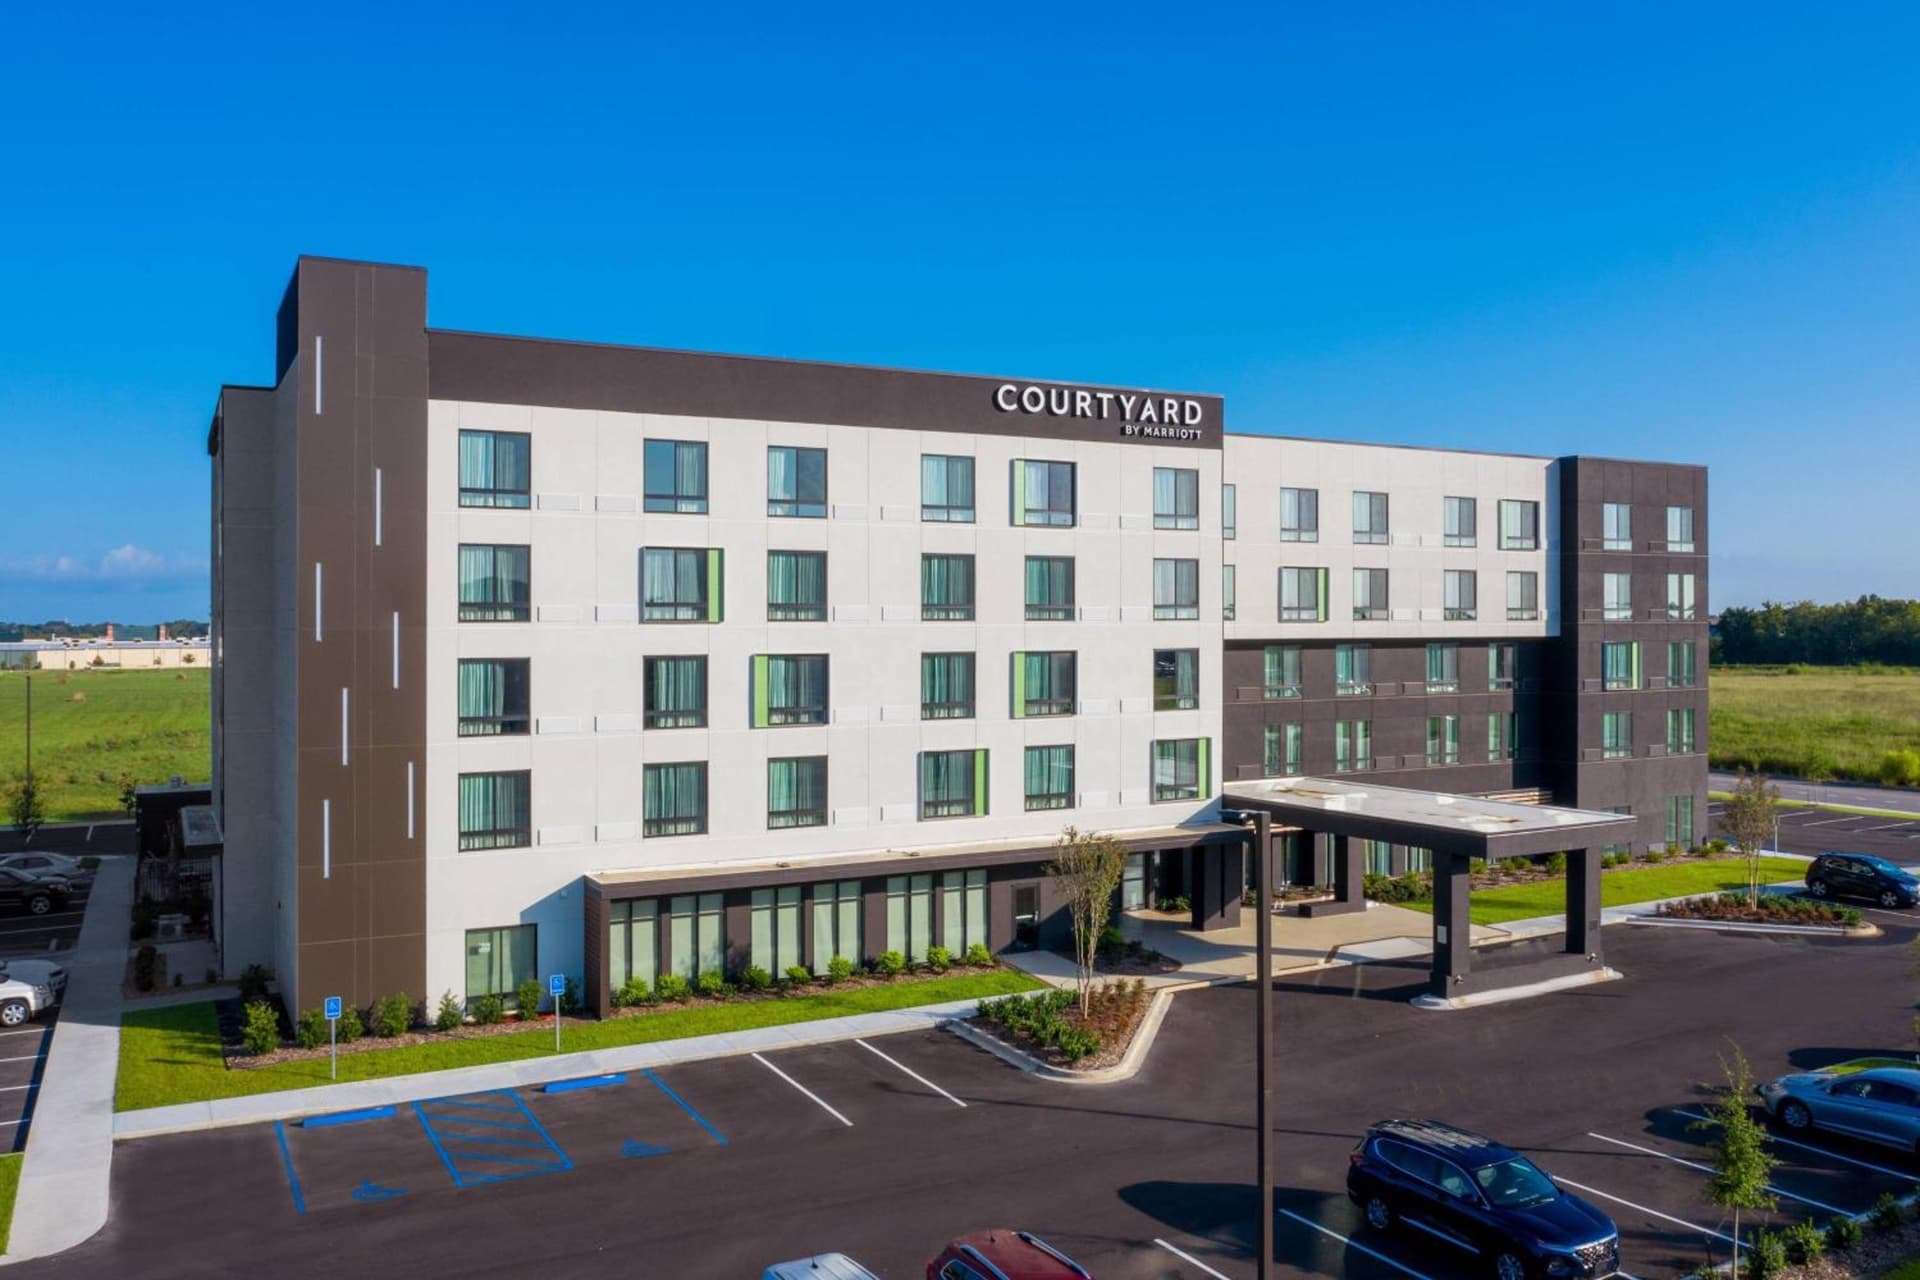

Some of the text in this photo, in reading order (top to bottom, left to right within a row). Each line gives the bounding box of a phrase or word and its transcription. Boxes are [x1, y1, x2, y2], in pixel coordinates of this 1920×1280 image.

[997, 384, 1203, 425] COURTYARD
[1125, 424, 1203, 440] BY MARRIOTT
